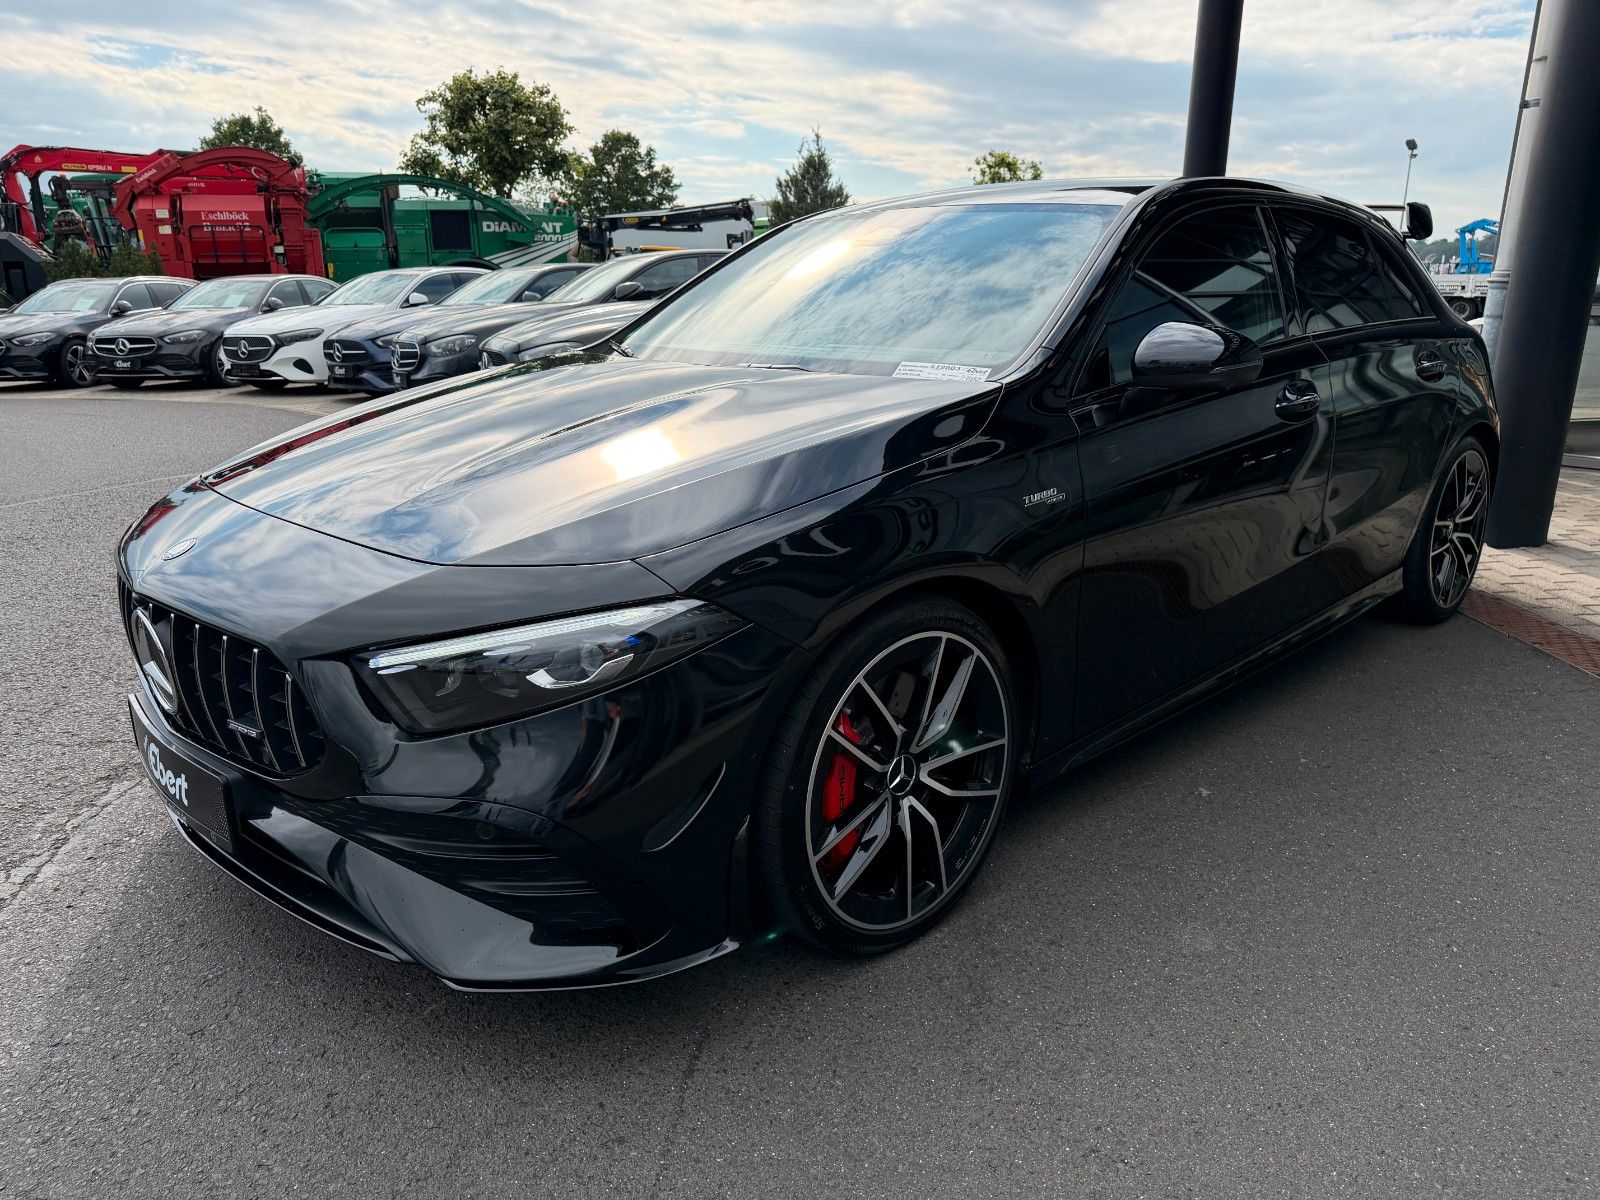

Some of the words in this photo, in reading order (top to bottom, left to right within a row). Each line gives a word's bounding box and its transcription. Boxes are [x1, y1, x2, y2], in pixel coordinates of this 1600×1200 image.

[201, 211, 249, 221] Eschlböck
[1022, 487, 1058, 504] TURBO
[149, 742, 189, 807] Ebert
